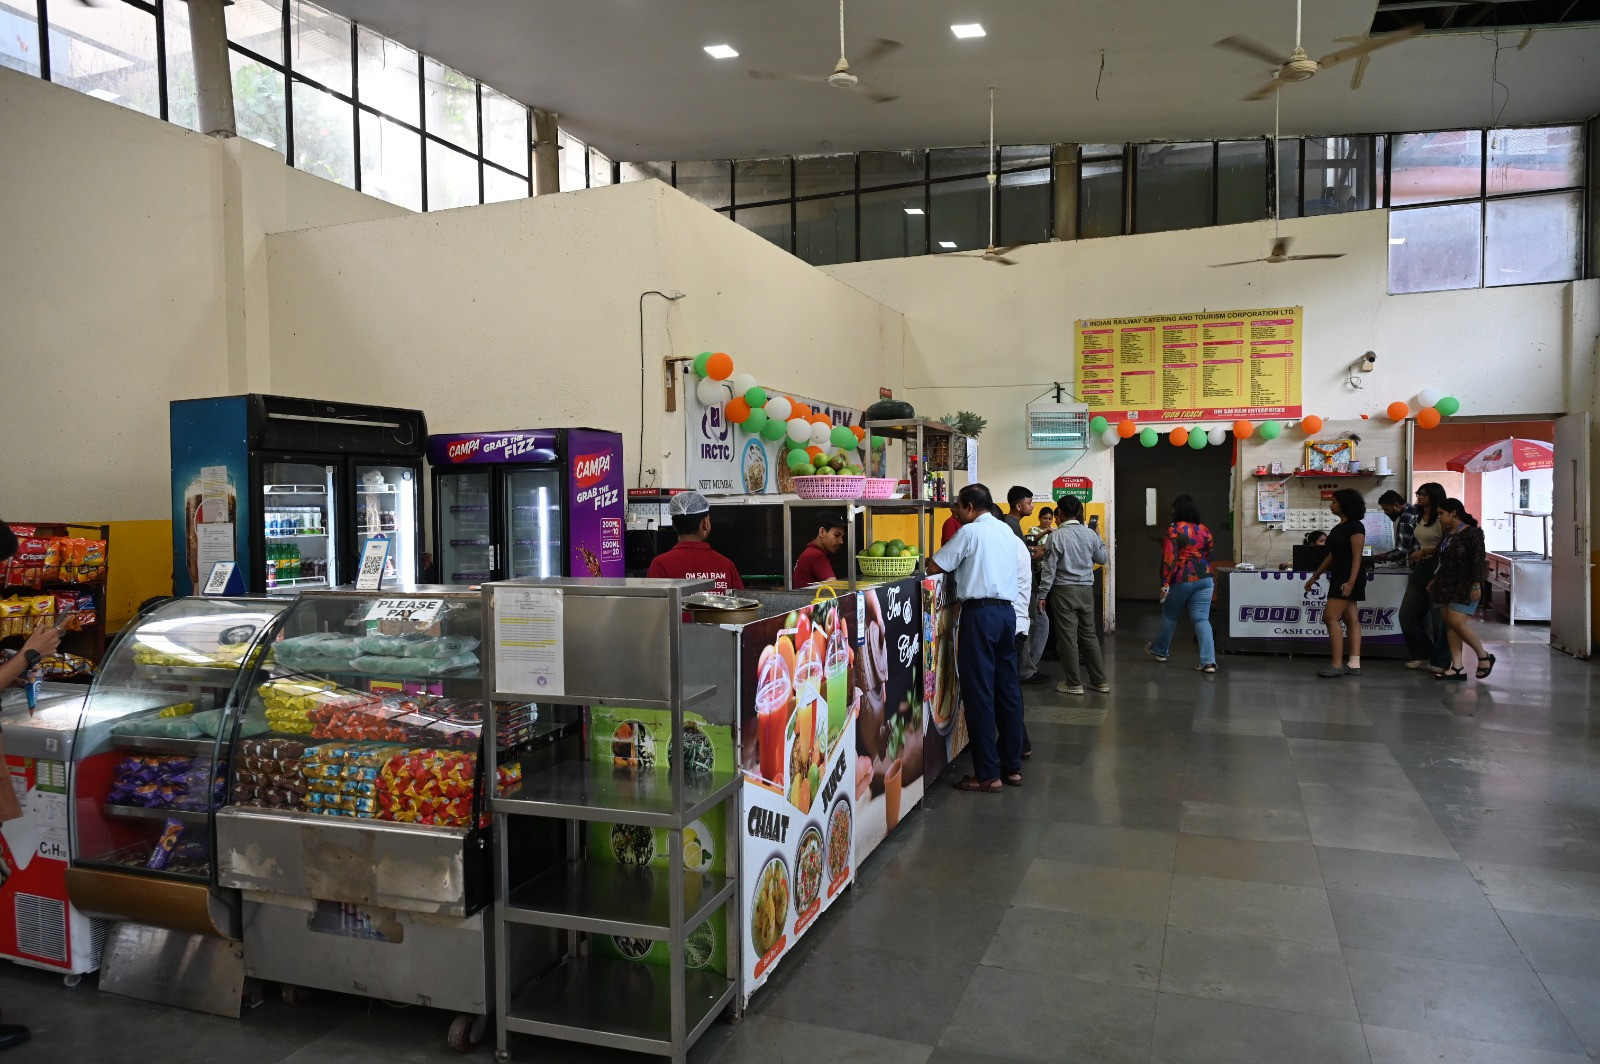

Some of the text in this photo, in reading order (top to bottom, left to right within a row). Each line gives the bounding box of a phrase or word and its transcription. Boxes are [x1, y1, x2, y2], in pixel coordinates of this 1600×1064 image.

[1113, 317, 1142, 325] RAILWAY
[1143, 315, 1177, 324] CATERING
[1194, 312, 1226, 320] TOURISM
[1227, 309, 1279, 319] CORPORATION
[1280, 308, 1296, 316] LTD.
[448, 438, 480, 458] CAMPA
[483, 434, 524, 453] GRAB THE
[504, 436, 535, 460] FIZZ
[700, 443, 730, 461] IRCTC
[576, 454, 611, 479] CAMPA
[576, 484, 610, 503] GRAB THE
[594, 488, 619, 511] FIZZ
[602, 520, 620, 528] 200ML
[612, 527, 619, 535] 10
[602, 541, 620, 549] 500ML
[612, 548, 620, 556] 20
[696, 572, 709, 580] SAI
[377, 600, 438, 610] PLEASE
[386, 609, 418, 618] PAY
[1238, 605, 1399, 626] FOOD TCK
[1274, 627, 1303, 635] CASH
[821, 747, 847, 815] JUICE
[747, 805, 790, 844] CHAAT
